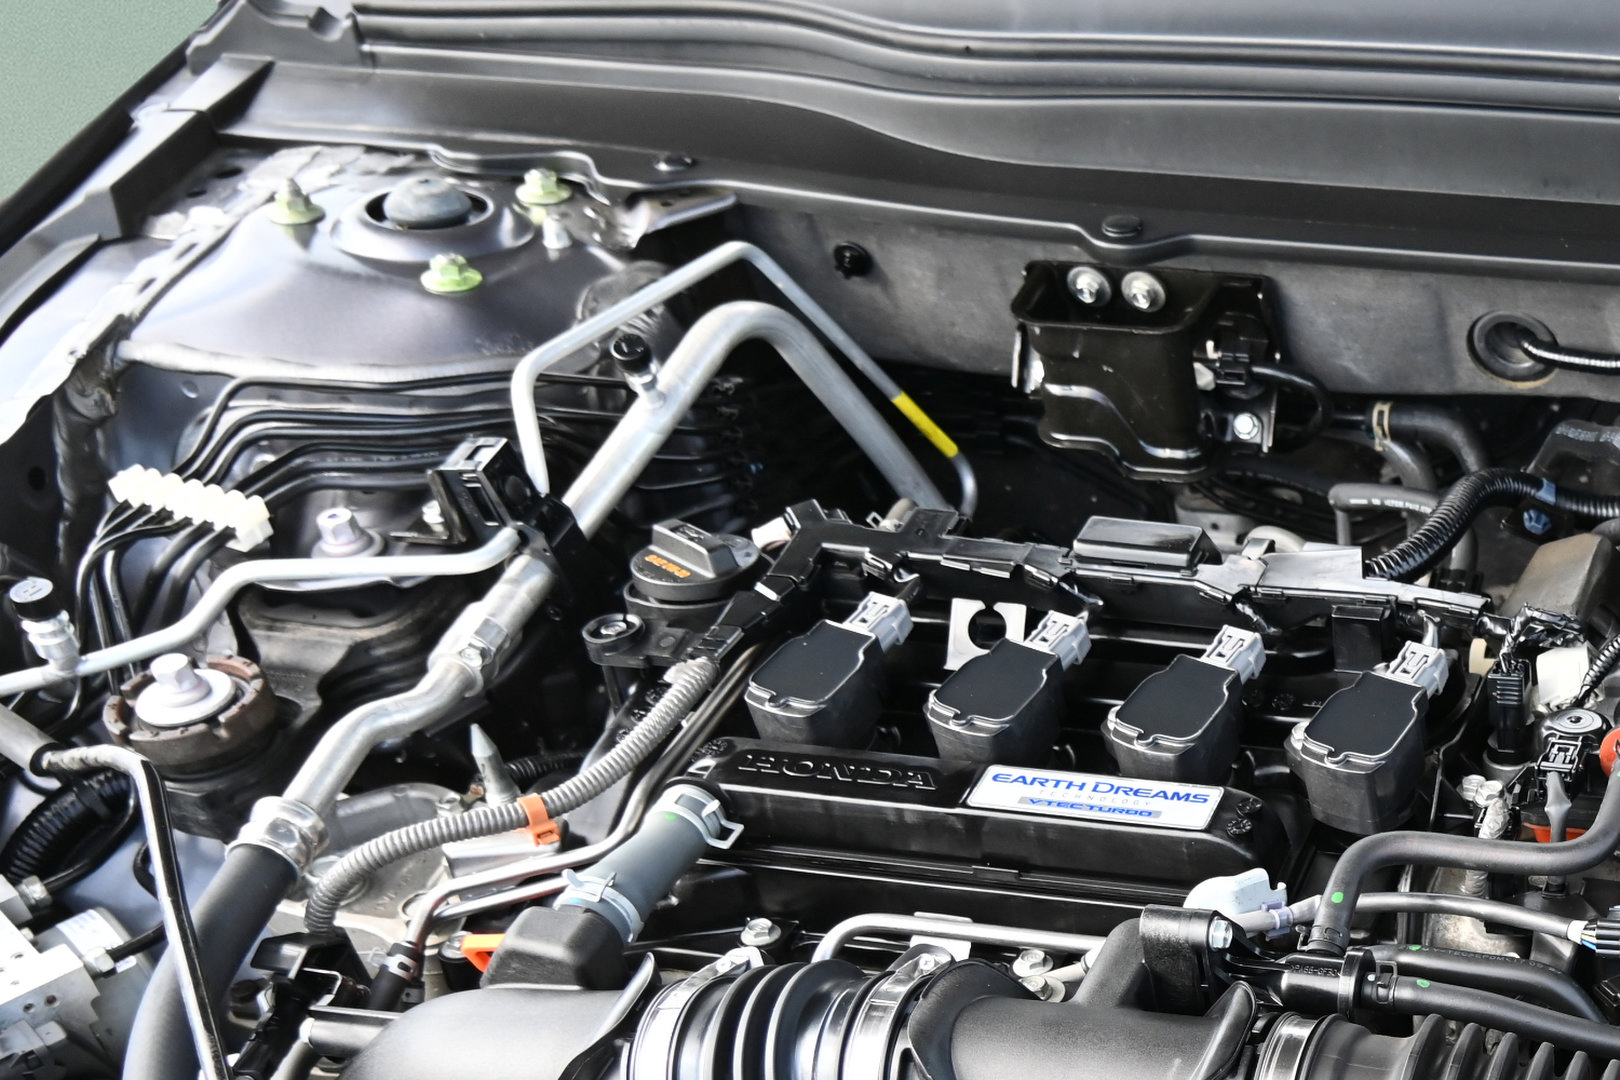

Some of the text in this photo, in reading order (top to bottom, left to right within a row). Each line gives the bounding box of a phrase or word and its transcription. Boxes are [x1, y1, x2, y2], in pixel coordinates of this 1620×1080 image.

[737, 754, 937, 791] HONDA
[992, 773, 1211, 805] EARTH DREAMS
[1039, 790, 1151, 806] TECHNOLOGY
[1028, 798, 1154, 817] VTEC TURBO
